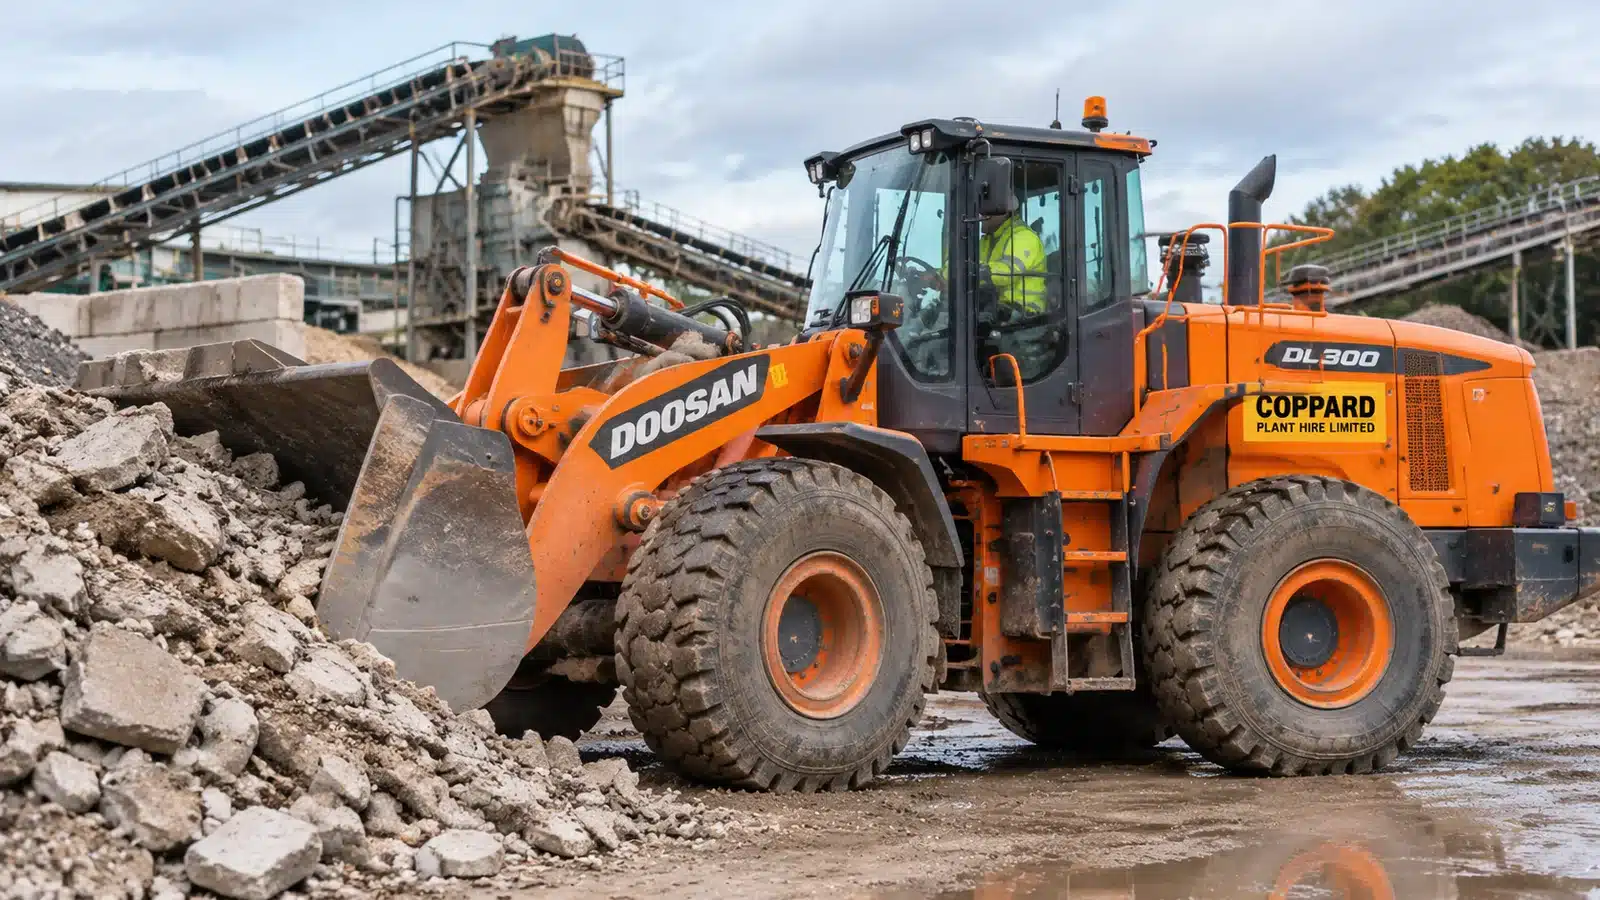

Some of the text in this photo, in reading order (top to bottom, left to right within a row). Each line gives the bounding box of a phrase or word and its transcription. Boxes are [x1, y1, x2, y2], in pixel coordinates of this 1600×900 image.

[1281, 347, 1380, 367] DL300
[610, 364, 757, 460] DOOSAN
[1256, 395, 1375, 418] COPPARD
[1257, 422, 1375, 432] PLANT HIRE LIMITED
